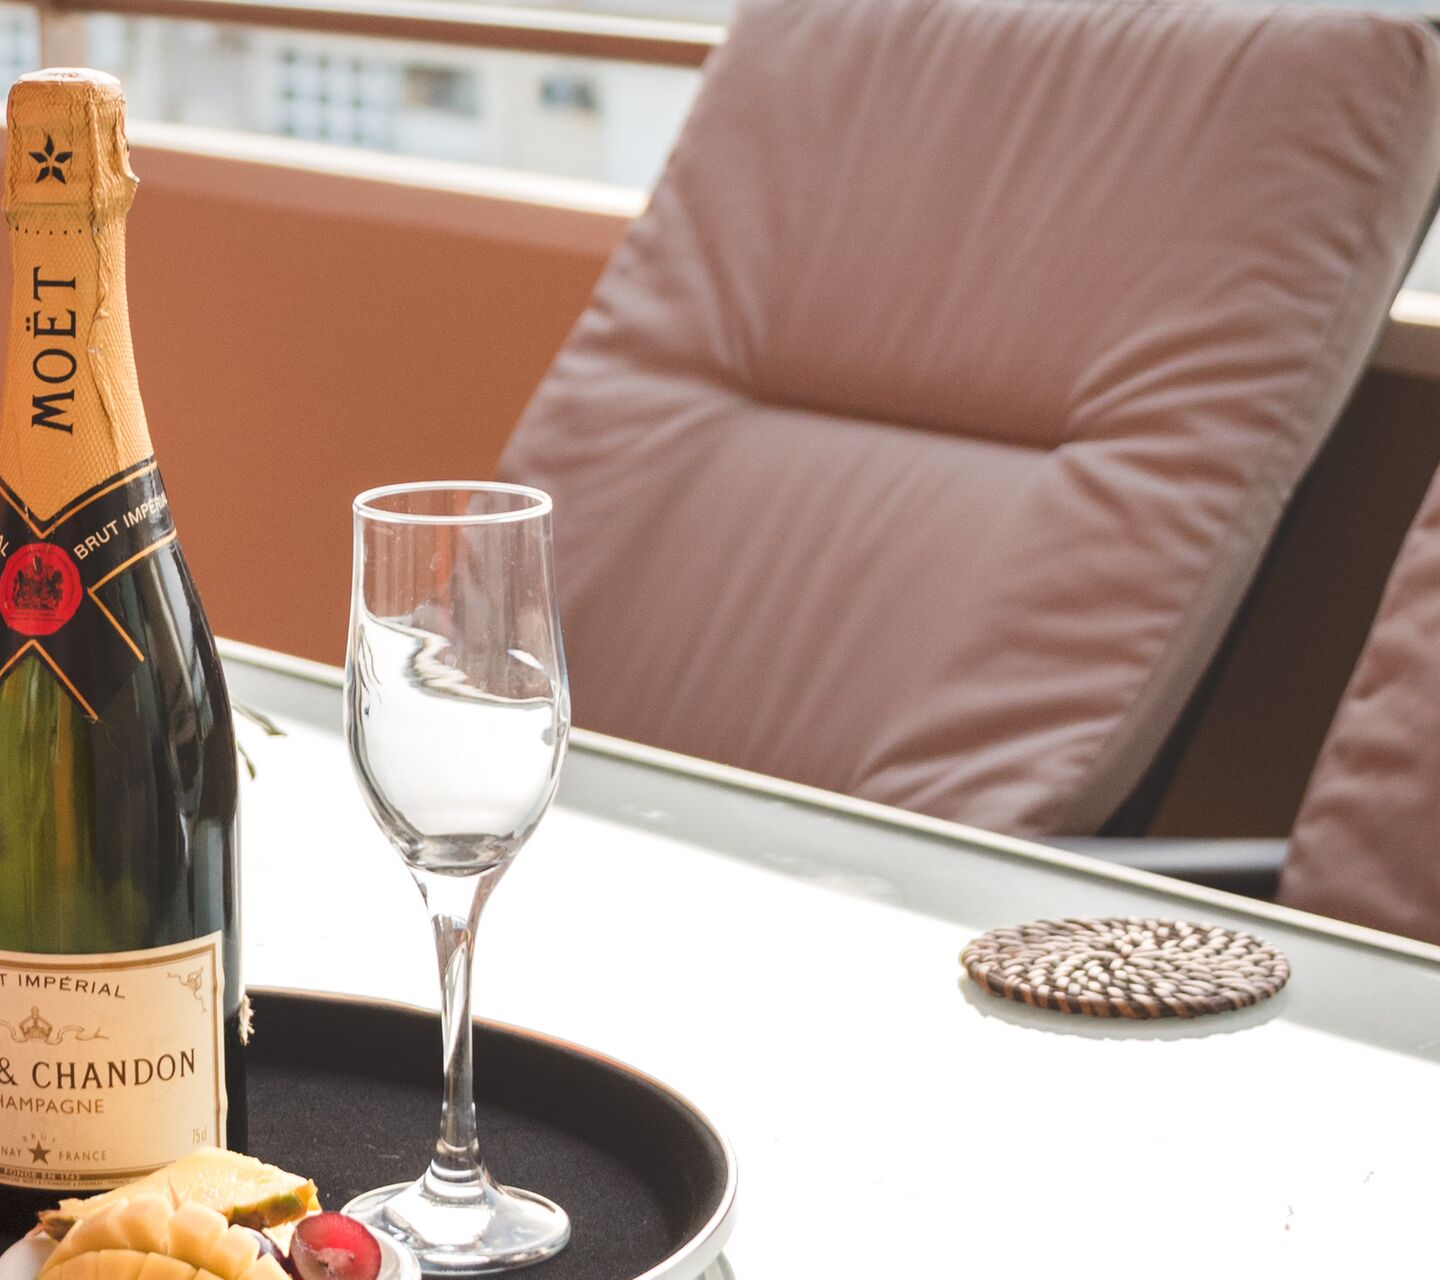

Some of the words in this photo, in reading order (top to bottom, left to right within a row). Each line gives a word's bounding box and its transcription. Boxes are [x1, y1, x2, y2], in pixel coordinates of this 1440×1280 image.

[26, 266, 77, 435] MOËT
[73, 520, 119, 560] BRUT
[18, 971, 126, 999] IMPÉRIAL
[32, 1048, 196, 1089] CHANDON
[59, 1150, 107, 1161] FRANCE
